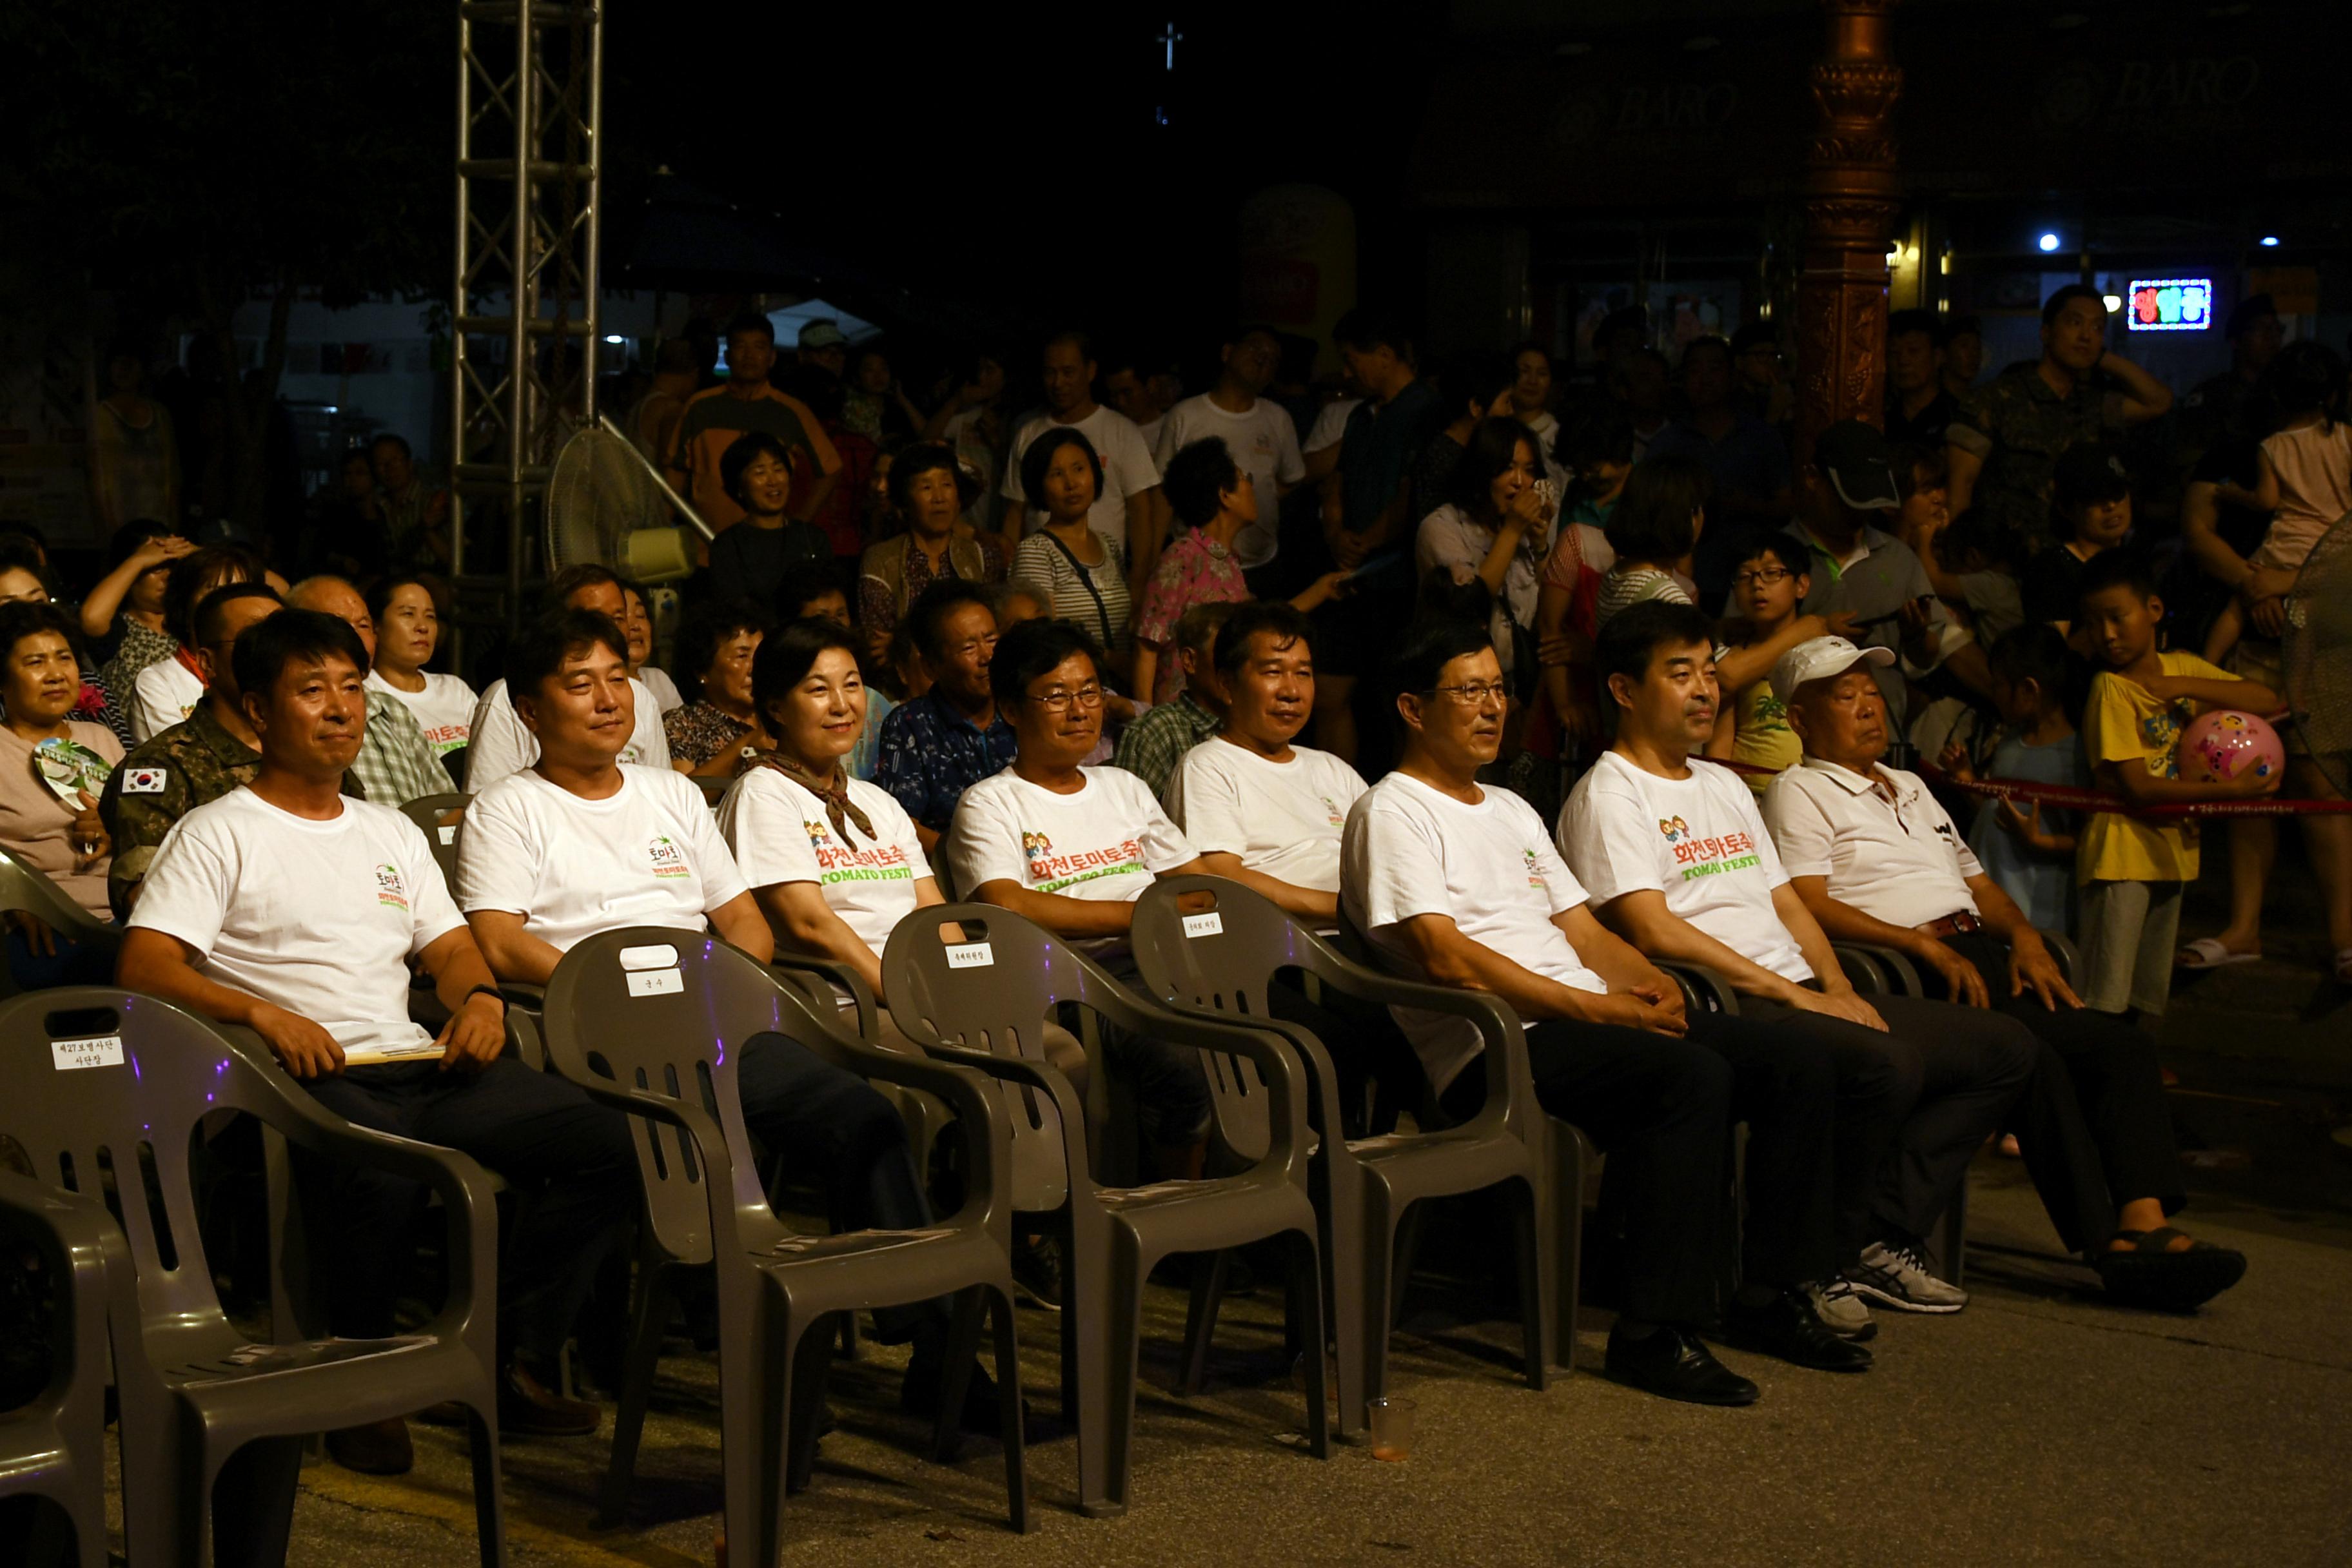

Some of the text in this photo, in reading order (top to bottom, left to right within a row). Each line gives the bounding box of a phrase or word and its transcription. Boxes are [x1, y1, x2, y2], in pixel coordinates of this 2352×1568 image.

[2112, 55, 2260, 108] BARO
[2134, 287, 2205, 323] 영업중
[649, 845, 678, 861] 토마토
[375, 872, 402, 889] 토마토
[75, 1054, 101, 1066] 사단장
